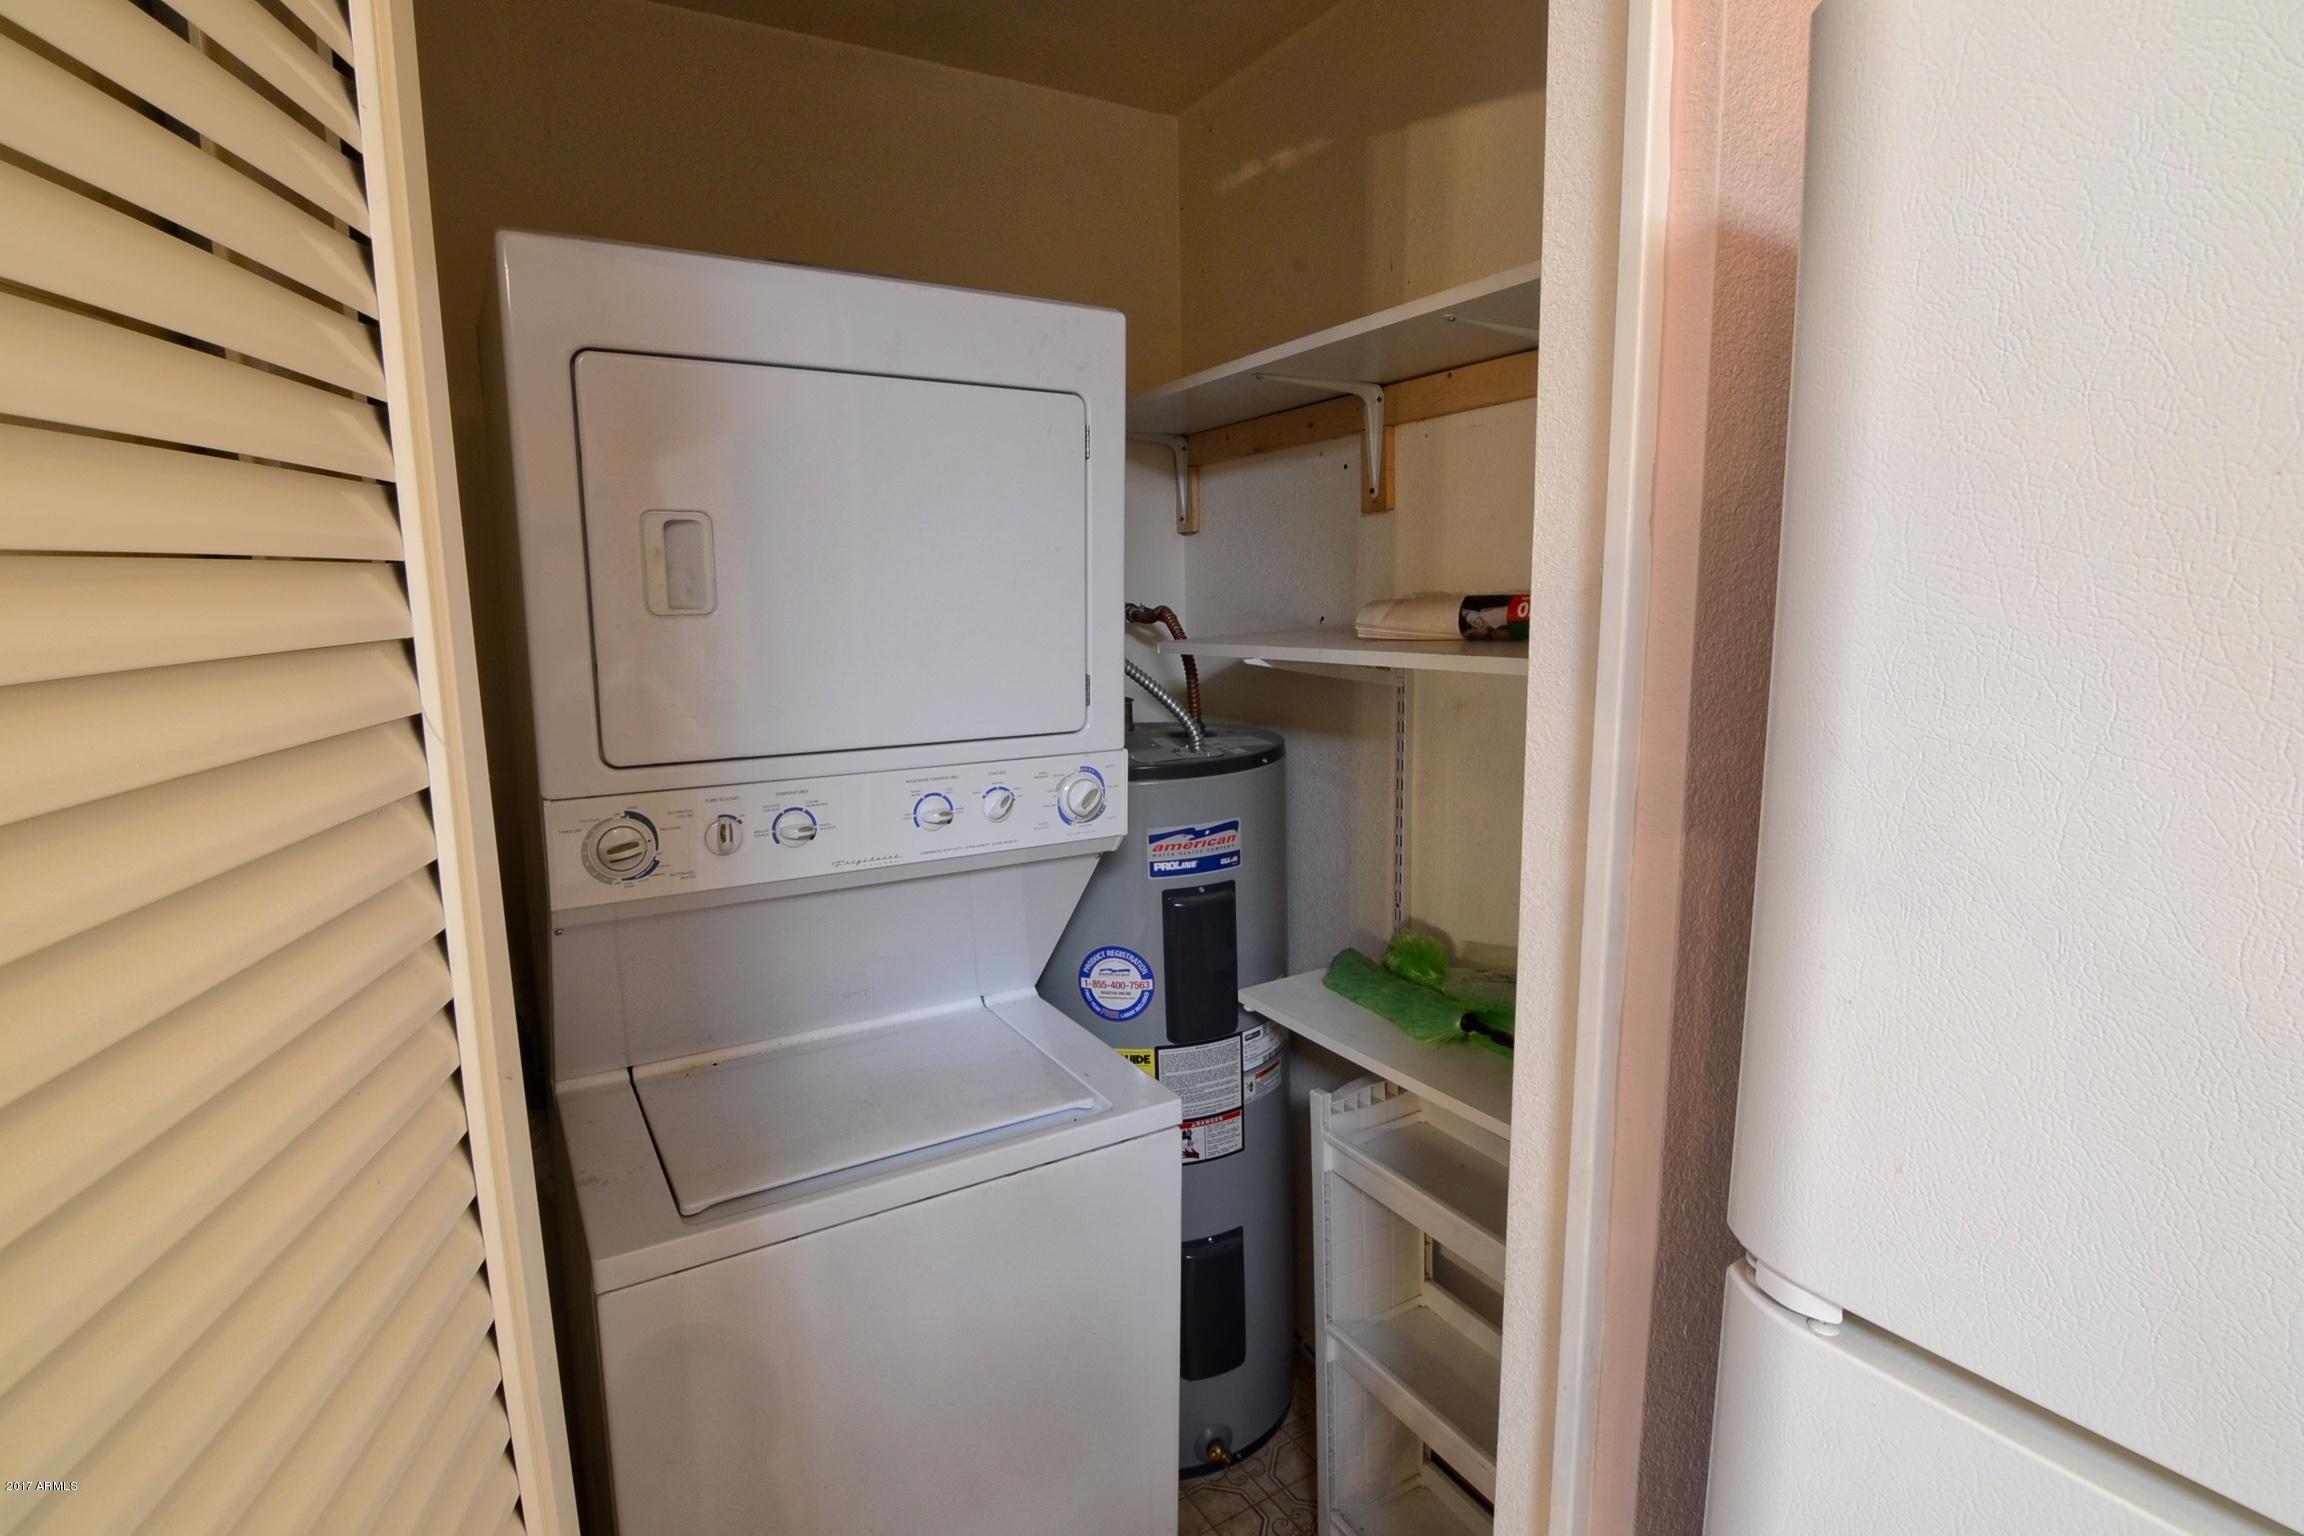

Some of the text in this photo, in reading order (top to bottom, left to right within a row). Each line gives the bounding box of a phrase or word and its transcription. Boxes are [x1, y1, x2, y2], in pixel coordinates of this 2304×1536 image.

[1152, 834, 1238, 852] american
[831, 854, 902, 868] Frigidaire
[1083, 949, 1149, 975] PRODUCT REGISTRATION
[1084, 979, 1150, 990] 1-855-400-7563
